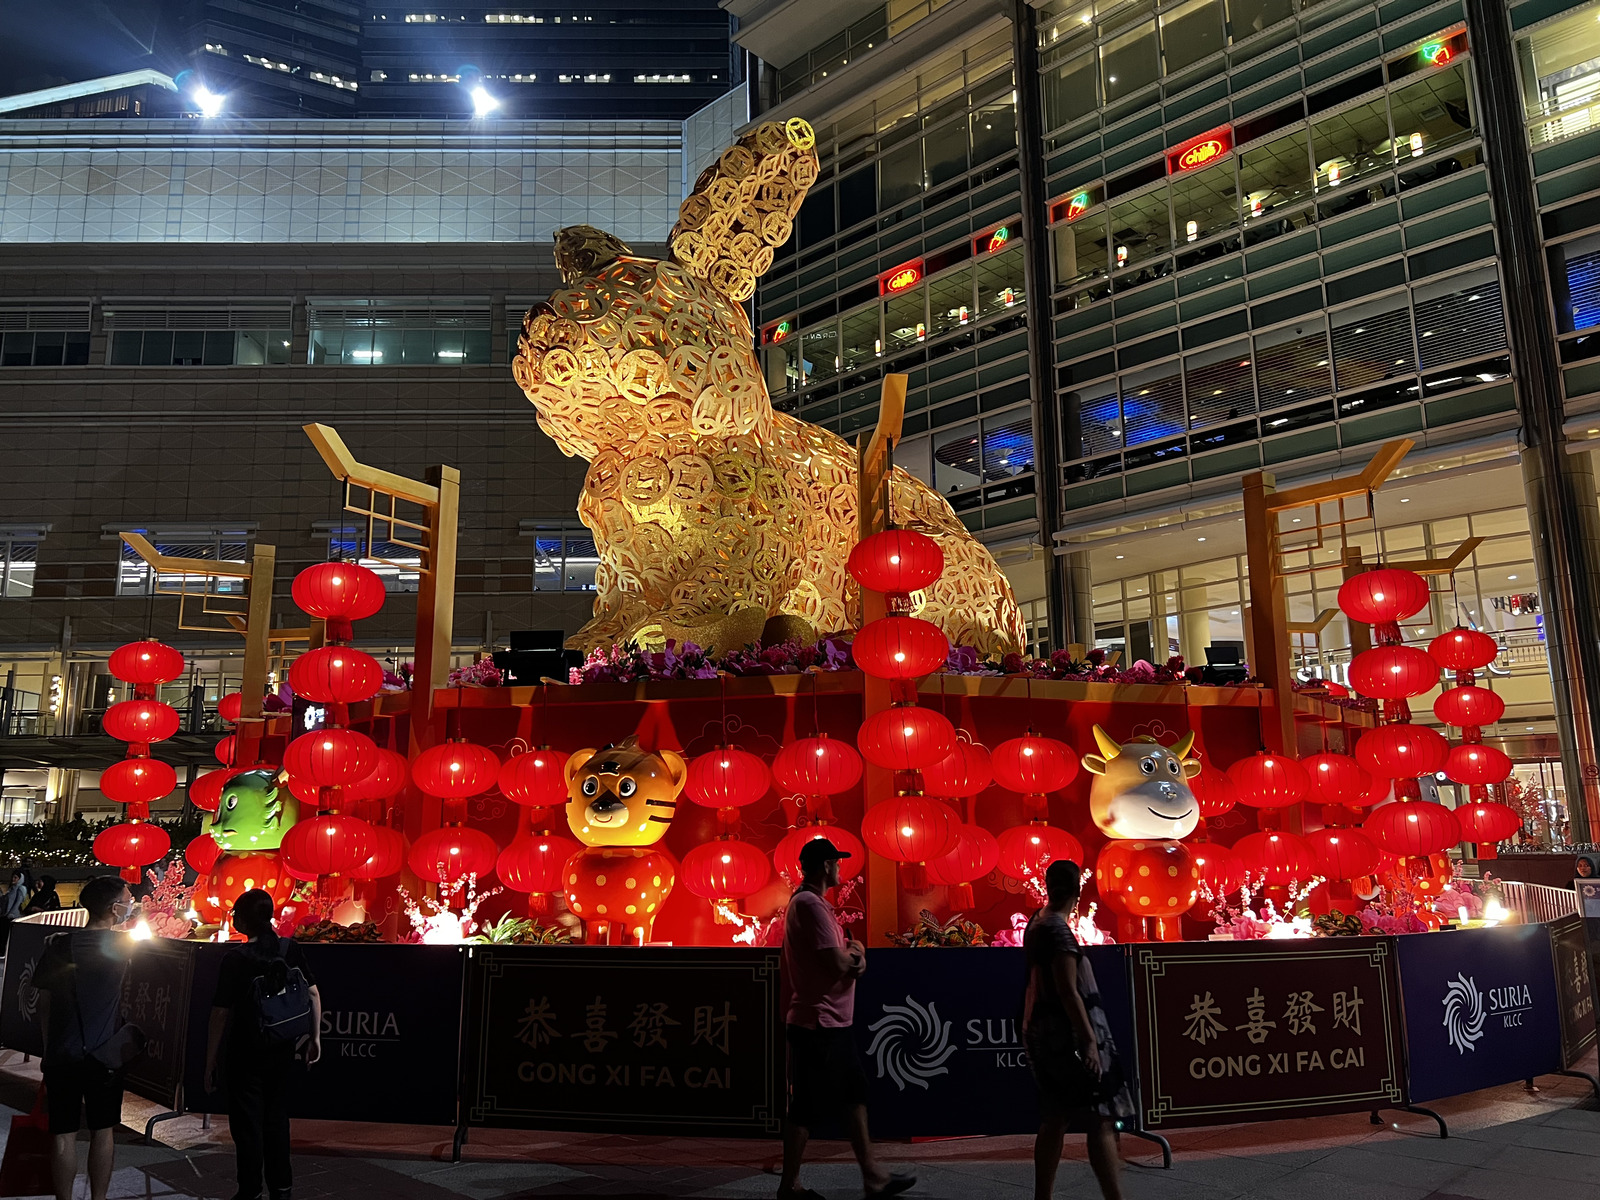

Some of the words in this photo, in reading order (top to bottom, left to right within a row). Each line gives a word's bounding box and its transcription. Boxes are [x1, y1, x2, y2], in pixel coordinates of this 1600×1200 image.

[1489, 984, 1532, 1010] SURIA
[321, 1011, 400, 1035] SURIA
[513, 995, 737, 1056] 恭喜發財
[1182, 986, 1364, 1046] 恭喜發財
[1503, 1013, 1522, 1028] KLCC
[341, 1043, 377, 1057] KLCC
[996, 1052, 1027, 1068] KLC
[1189, 1055, 1261, 1079] GONG
[1268, 1052, 1289, 1074] XI
[1297, 1050, 1325, 1072] FA
[1329, 1047, 1365, 1069] CAI
[517, 1060, 596, 1085] GONG
[605, 1064, 630, 1087] XI
[640, 1065, 675, 1088] FA
[683, 1066, 732, 1088] CAI
